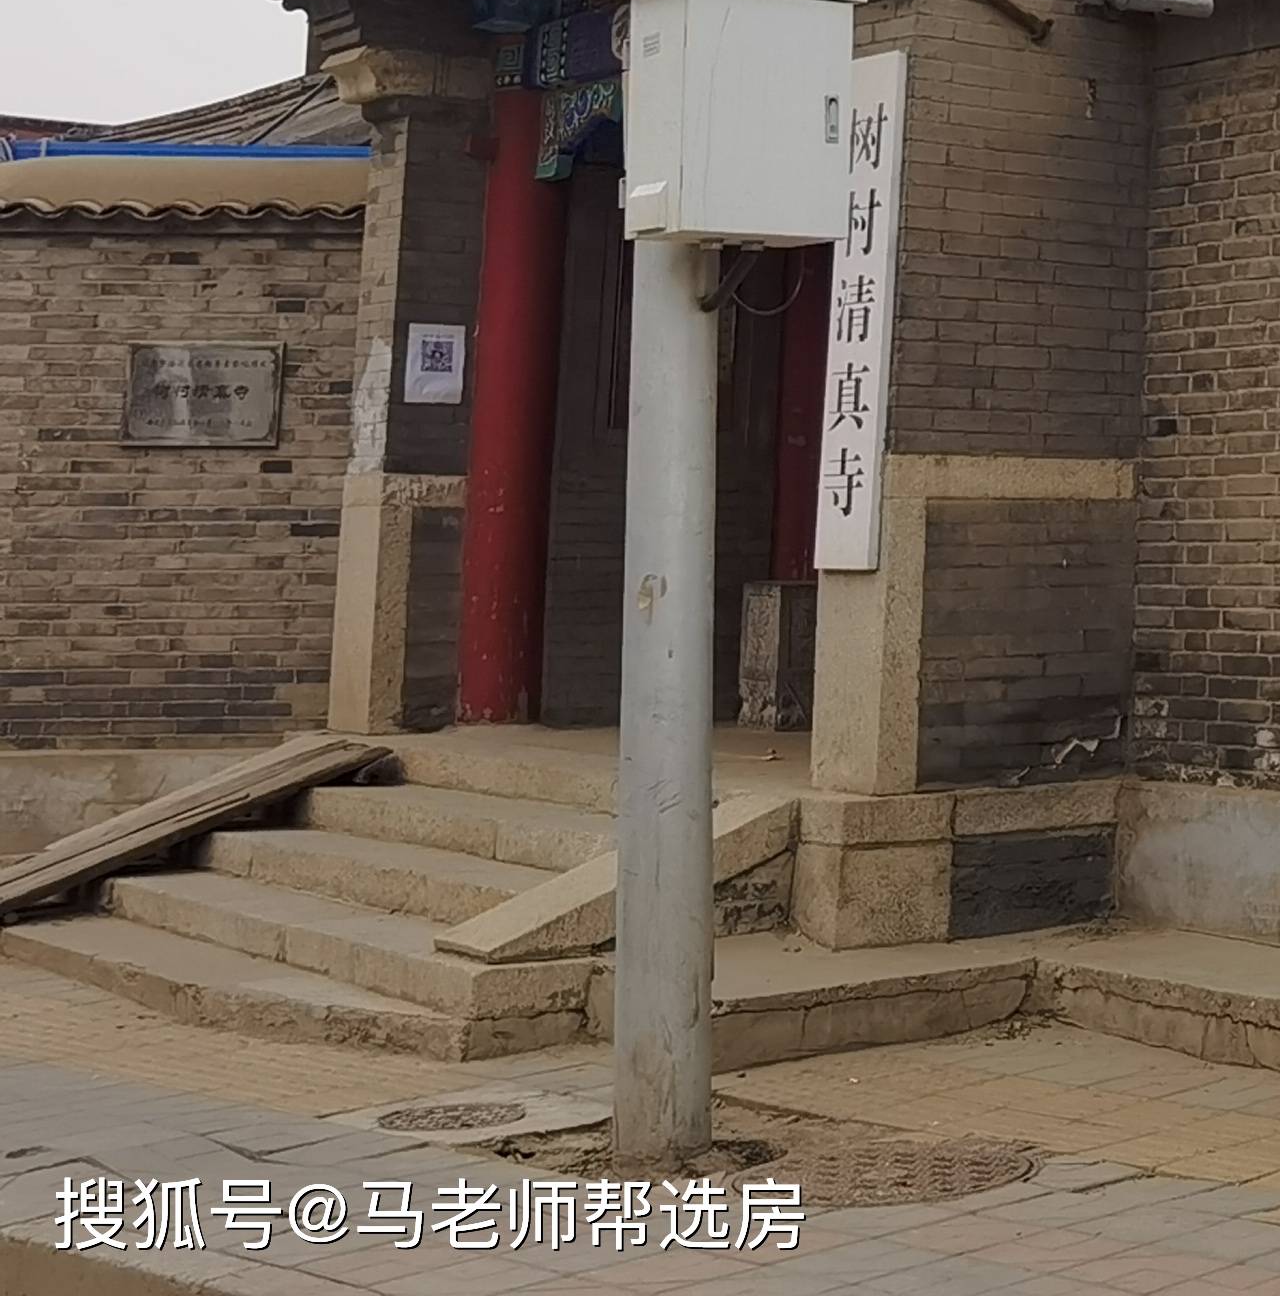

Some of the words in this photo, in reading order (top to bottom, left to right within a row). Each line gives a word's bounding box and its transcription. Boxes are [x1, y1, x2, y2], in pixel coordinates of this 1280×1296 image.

[823, 102, 889, 517] 树村清真寺
